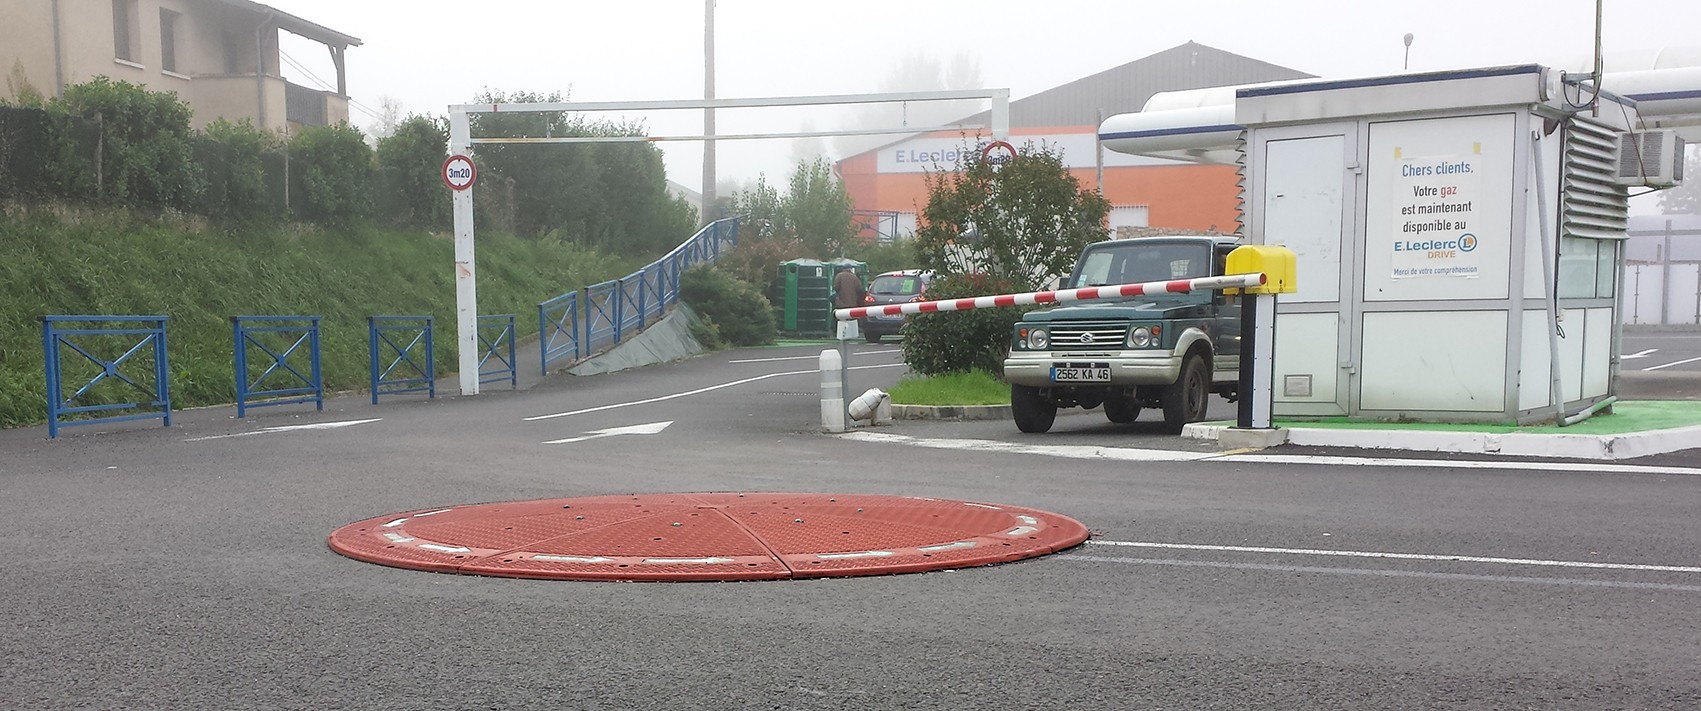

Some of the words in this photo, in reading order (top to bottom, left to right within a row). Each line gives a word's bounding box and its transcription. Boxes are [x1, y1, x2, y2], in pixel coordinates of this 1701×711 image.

[448, 168, 470, 178] 3m20
[1402, 164, 1432, 177] Chers
[1413, 185, 1438, 197] Votre
[1440, 186, 1457, 198] gaz
[1401, 204, 1416, 215] est
[1418, 200, 1472, 215] maintenant
[1403, 219, 1452, 234] disponible
[1454, 221, 1466, 230] au
[1394, 240, 1457, 252] E.Leclerc
[1428, 251, 1456, 259] DRIVE
[1393, 268, 1410, 276] Merci
[1419, 267, 1433, 275] votre
[1056, 369, 1078, 379] 2562
[1082, 369, 1093, 379] KA
[1097, 369, 1109, 379] 46
